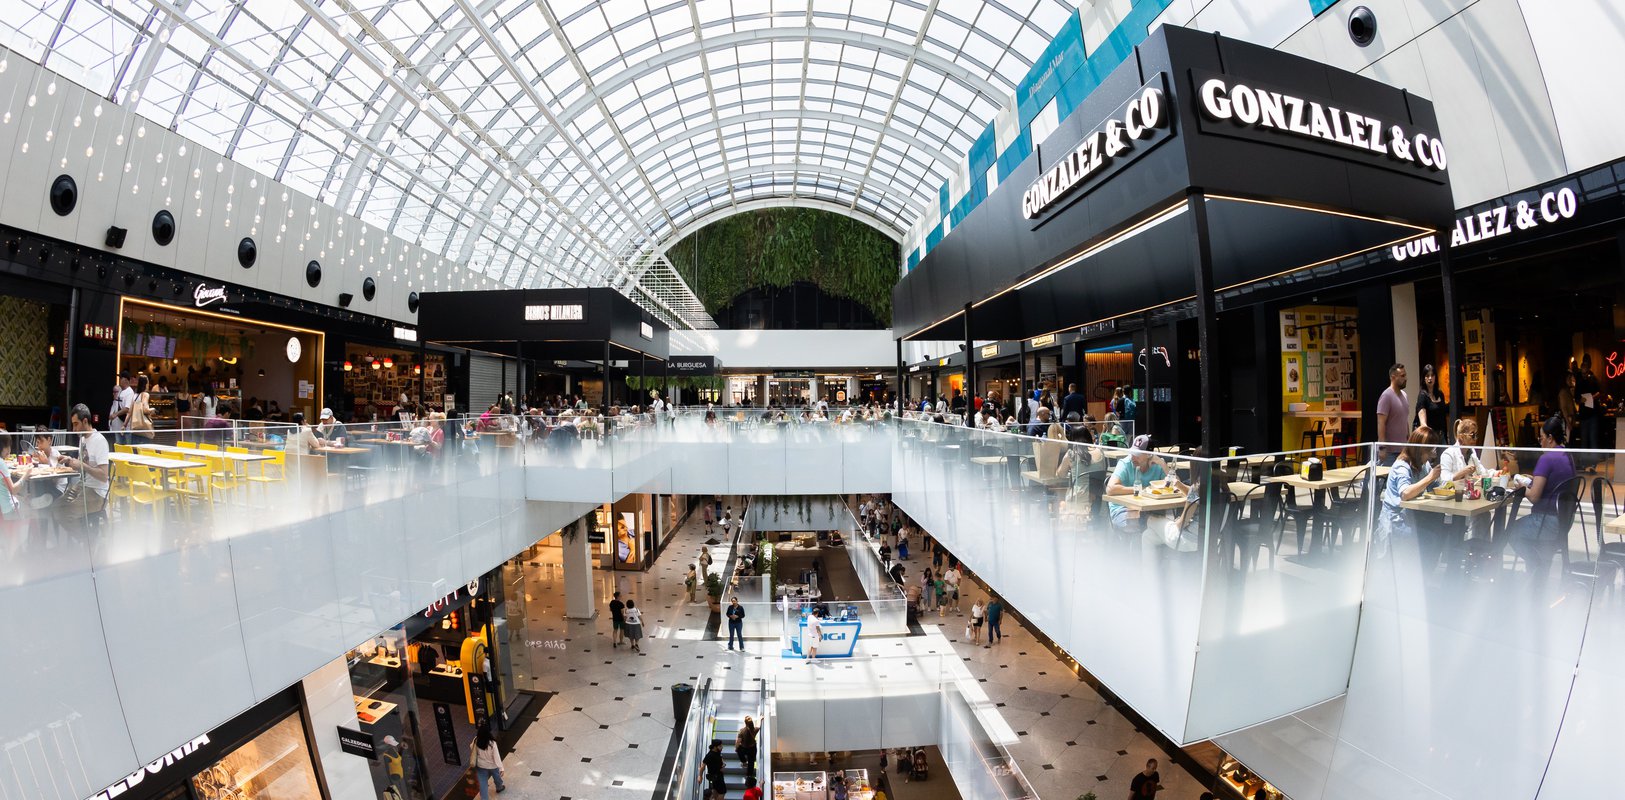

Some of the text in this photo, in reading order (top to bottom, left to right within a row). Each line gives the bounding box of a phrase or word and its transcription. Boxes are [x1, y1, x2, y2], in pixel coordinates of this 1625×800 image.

[1028, 50, 1064, 98] Diagonal Mar
[1022, 87, 1161, 220] GONZALEZ & CO
[1201, 78, 1447, 171] GONZALEZ & CO
[1392, 187, 1577, 261] GONALEZ & CO
